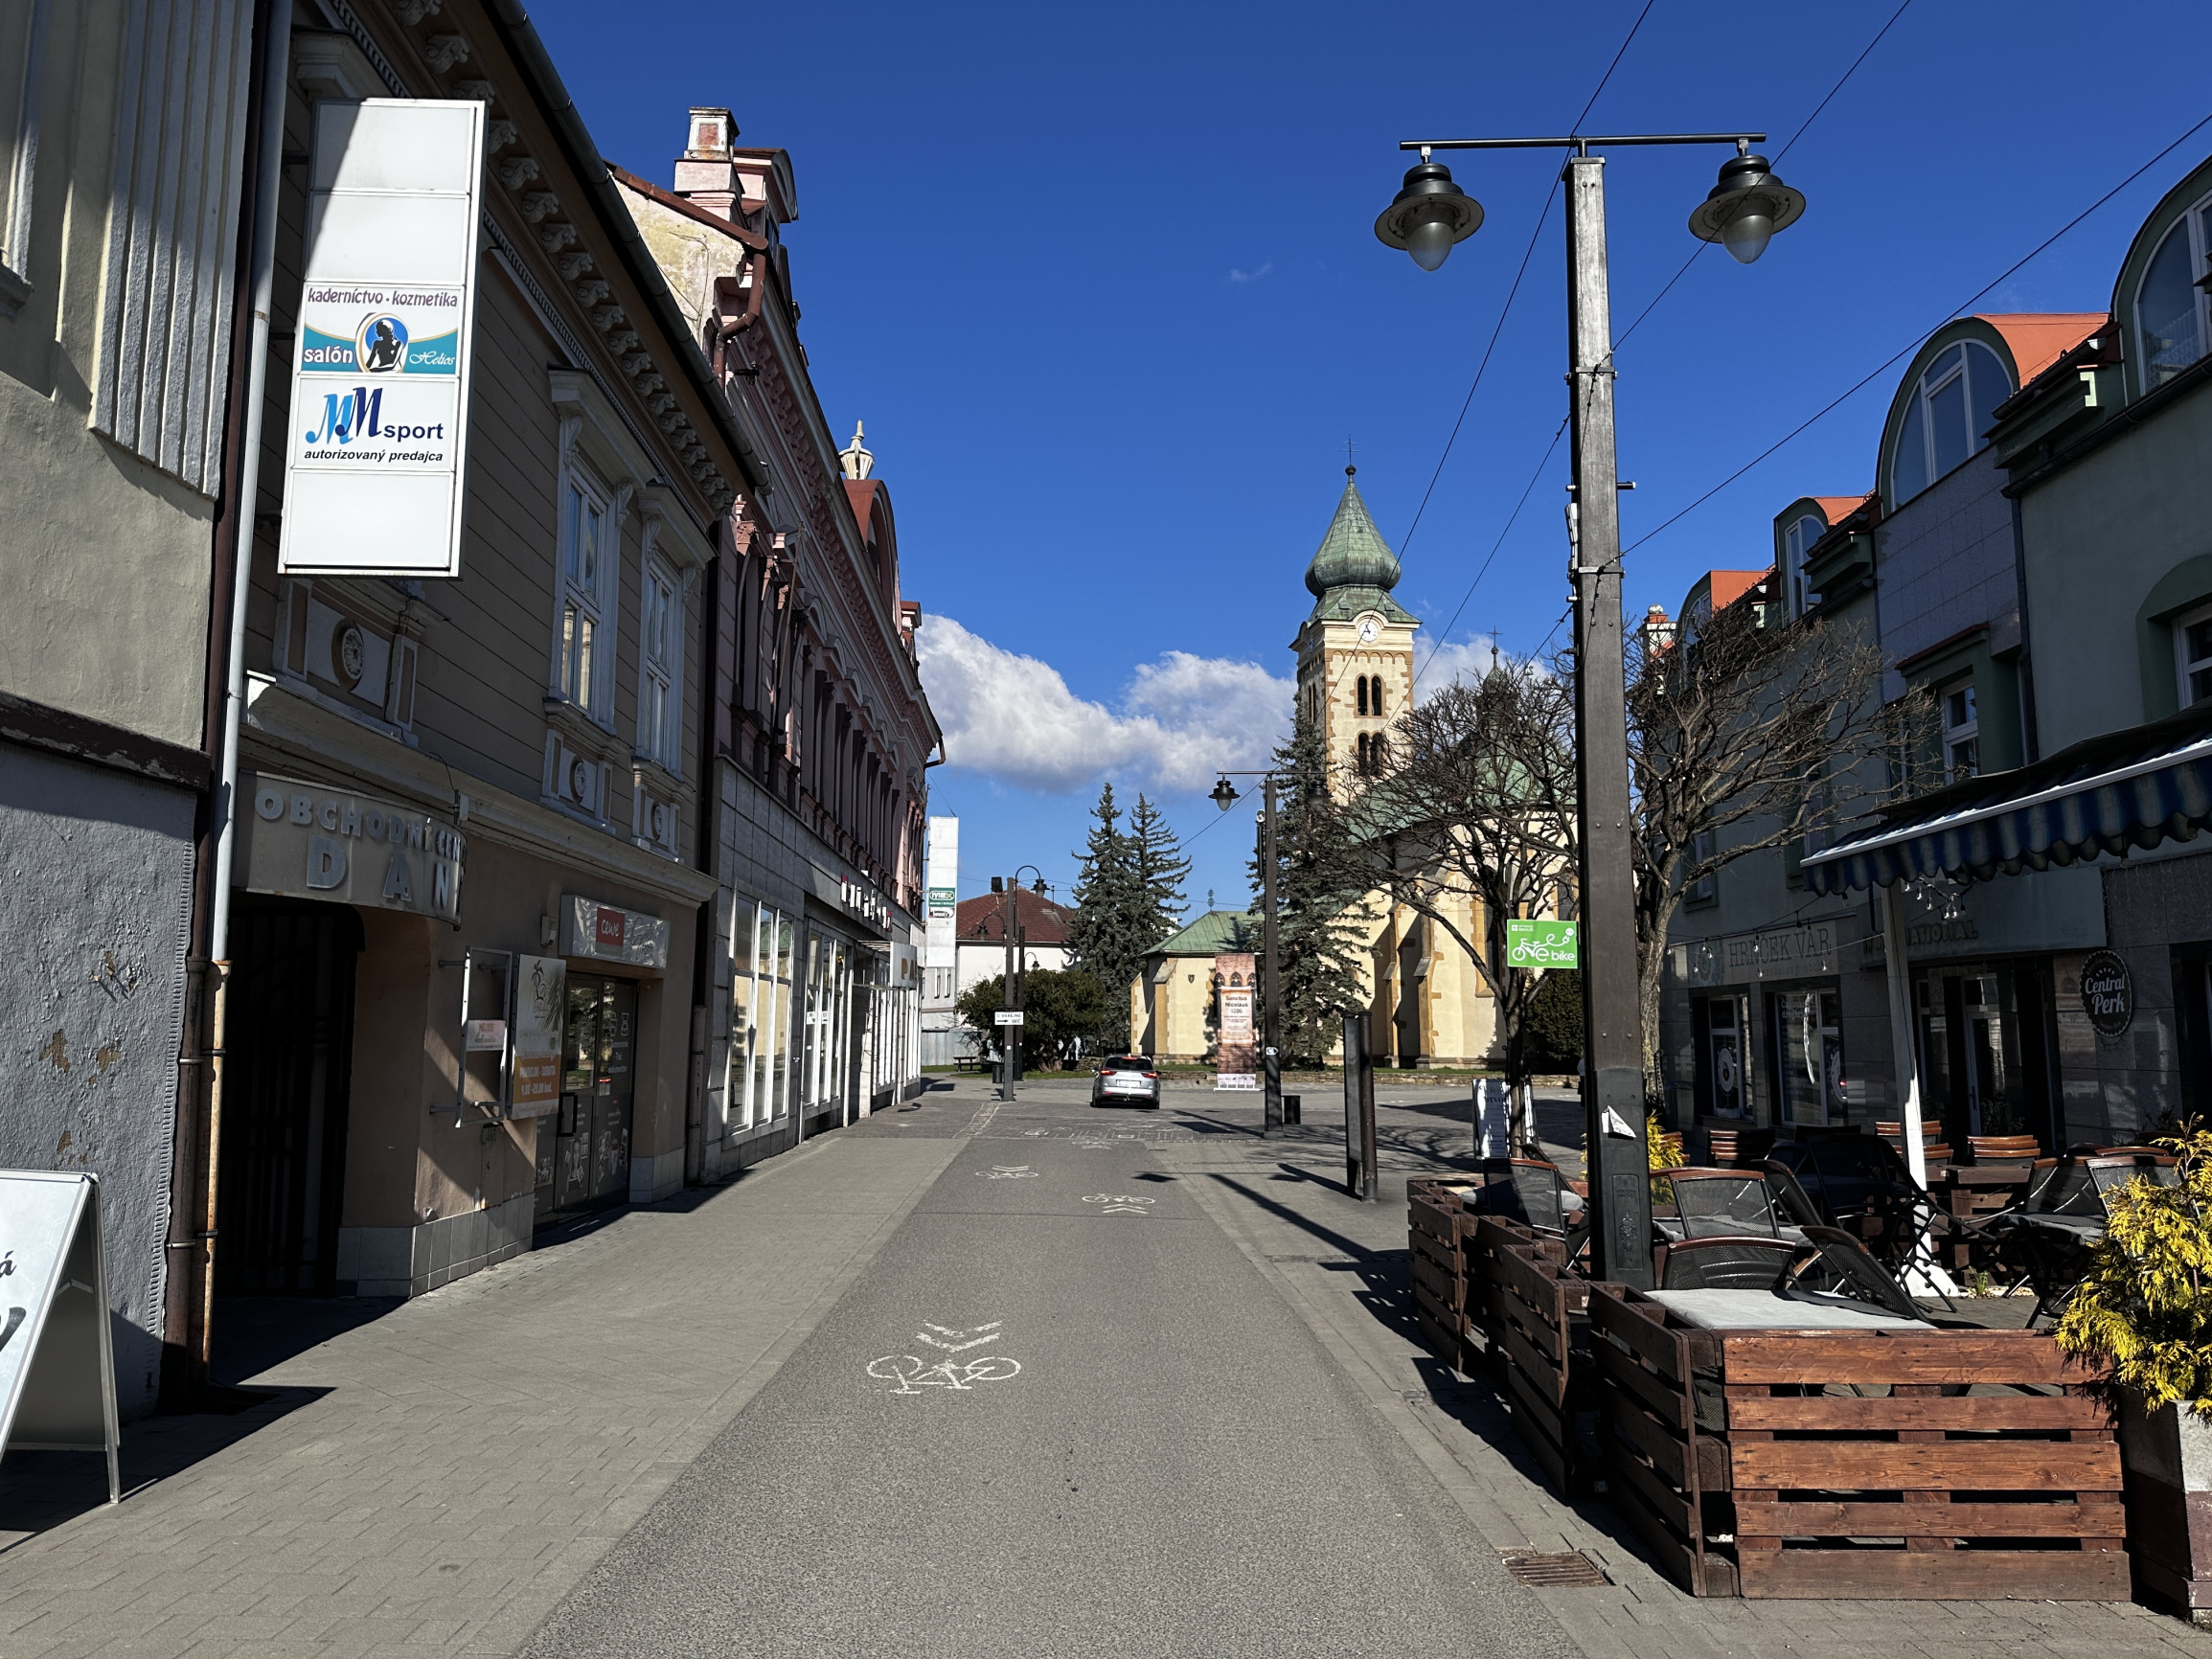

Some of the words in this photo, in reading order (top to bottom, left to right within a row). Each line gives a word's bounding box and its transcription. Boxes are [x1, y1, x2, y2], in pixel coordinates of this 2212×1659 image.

[308, 287, 383, 305] kaderníctvo
[392, 290, 458, 307] kozmetika
[304, 345, 353, 364] salón
[409, 351, 455, 366] Helios
[383, 422, 444, 443] sport
[304, 449, 386, 463] autorizovaný
[388, 450, 444, 464] predajca
[306, 834, 450, 911] DAN
[601, 919, 620, 937] cewe
[1551, 950, 1576, 962] bike
[1727, 933, 1792, 967] HRNČEK
[2084, 973, 2125, 995] Central
[2091, 991, 2126, 1015] Perk
